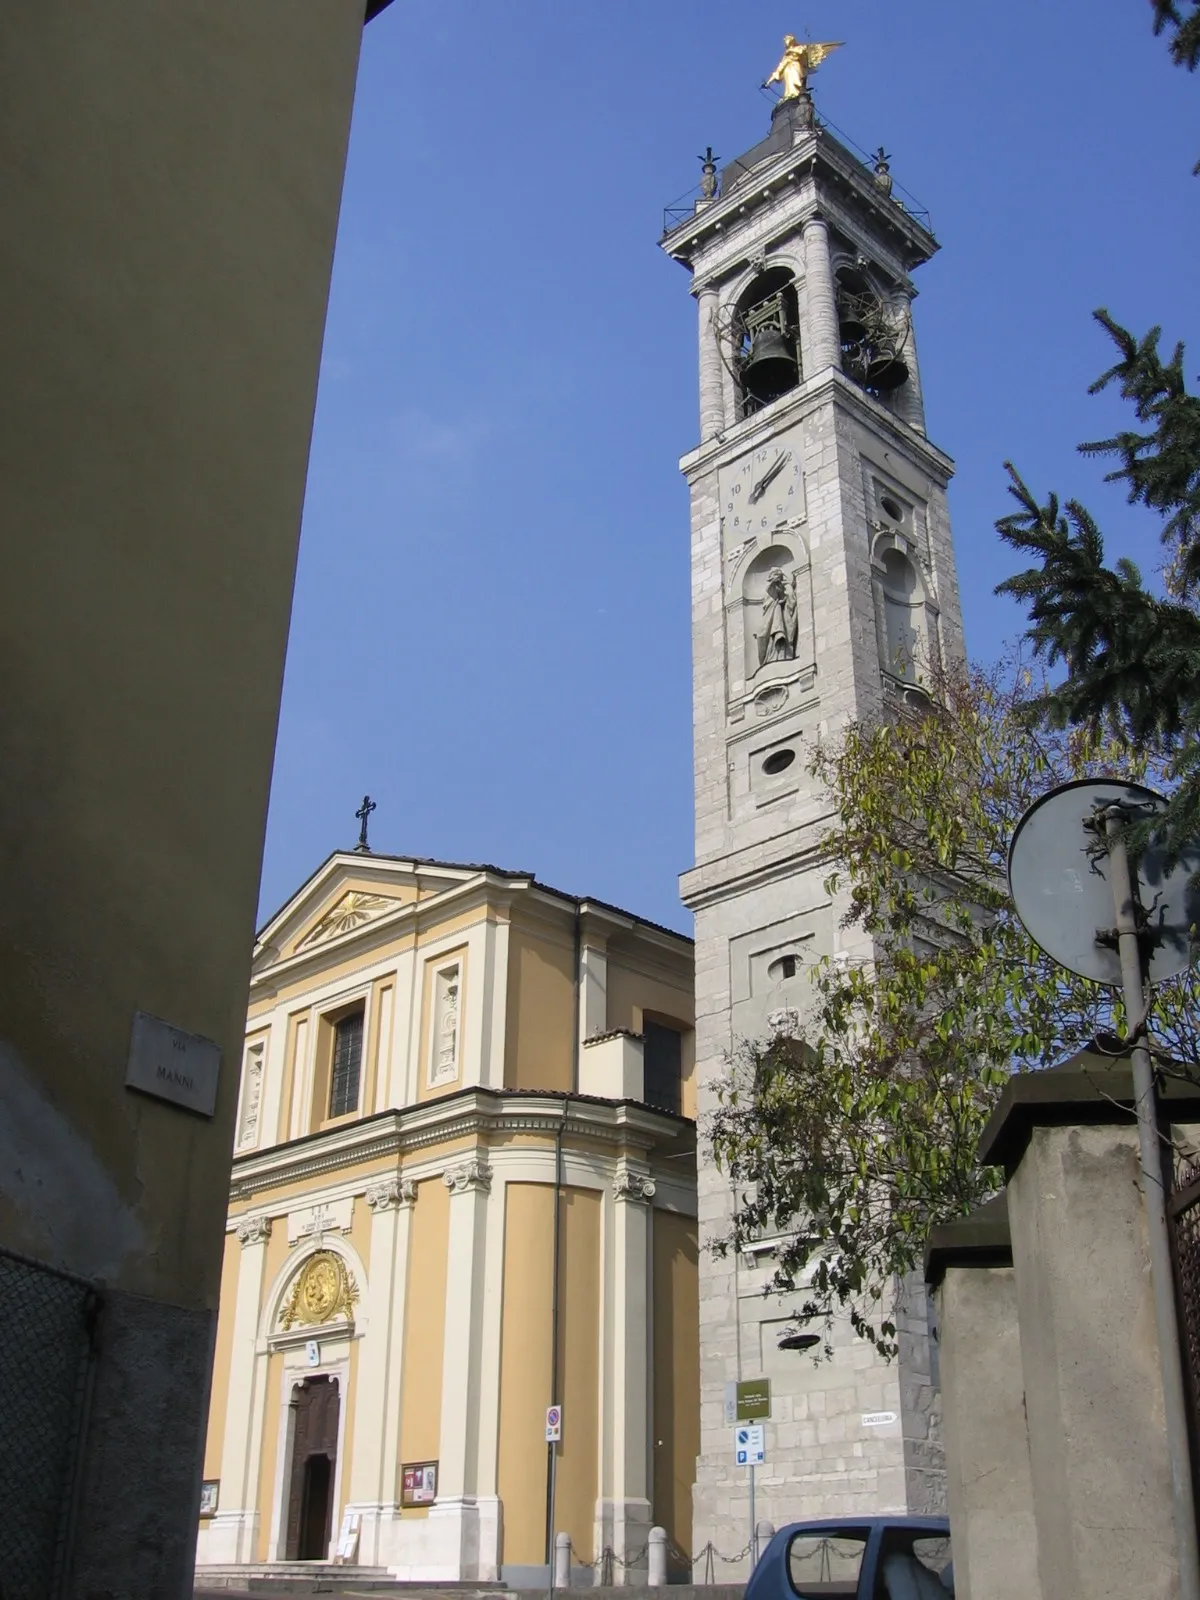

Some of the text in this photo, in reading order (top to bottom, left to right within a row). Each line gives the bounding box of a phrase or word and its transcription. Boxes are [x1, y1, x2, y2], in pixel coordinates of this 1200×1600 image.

[756, 450, 768, 463] 12
[774, 448, 779, 456] 1
[786, 451, 793, 462] 2
[742, 464, 751, 475] 11
[793, 465, 799, 476] 3
[731, 484, 741, 496] 10
[788, 486, 794, 496] 4
[727, 503, 734, 512] 9
[776, 504, 783, 513] 5
[733, 516, 740, 526] 8
[746, 519, 752, 531] 7
[761, 516, 767, 527] 6
[172, 1039, 187, 1053] VIA
[156, 1065, 195, 1089] MANNI
